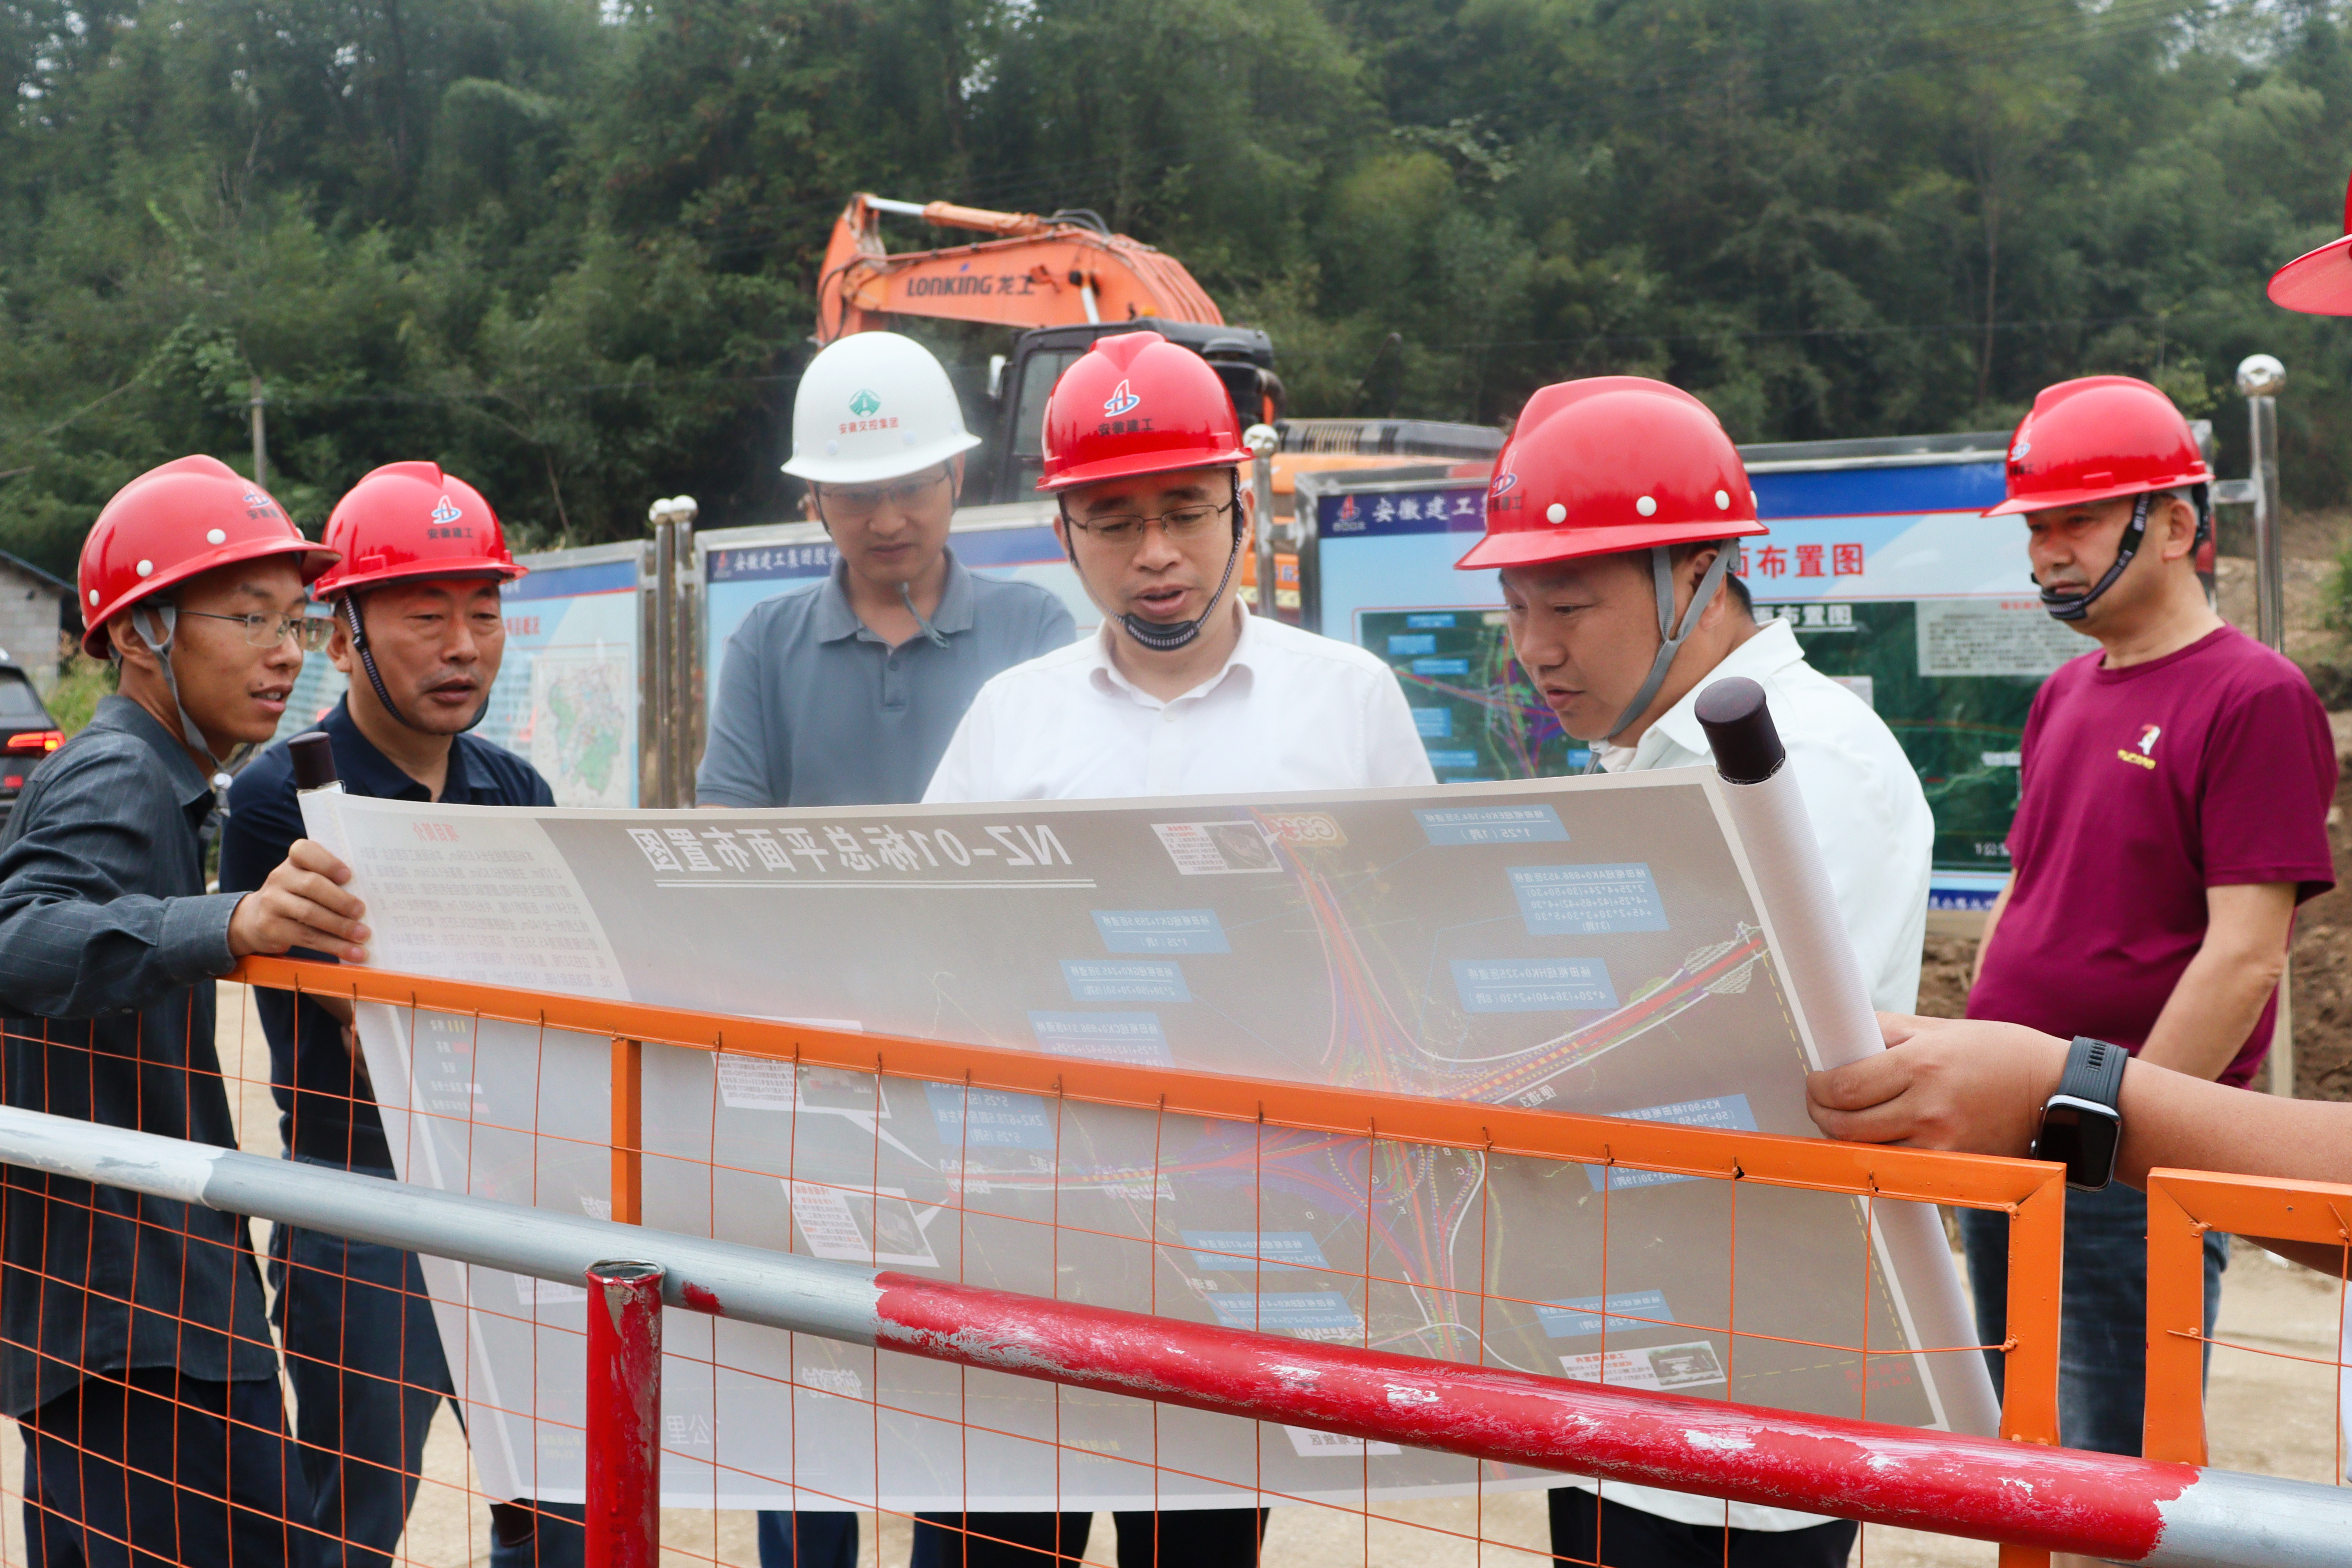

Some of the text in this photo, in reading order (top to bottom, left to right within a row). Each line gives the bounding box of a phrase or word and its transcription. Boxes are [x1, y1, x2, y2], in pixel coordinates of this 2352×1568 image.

[907, 275, 993, 297] LONKING
[838, 417, 899, 435] 安徽交控集团
[1099, 418, 1155, 436] 安徽建工
[1372, 492, 1488, 523] 安徽建工
[427, 528, 474, 539] 安徽建工
